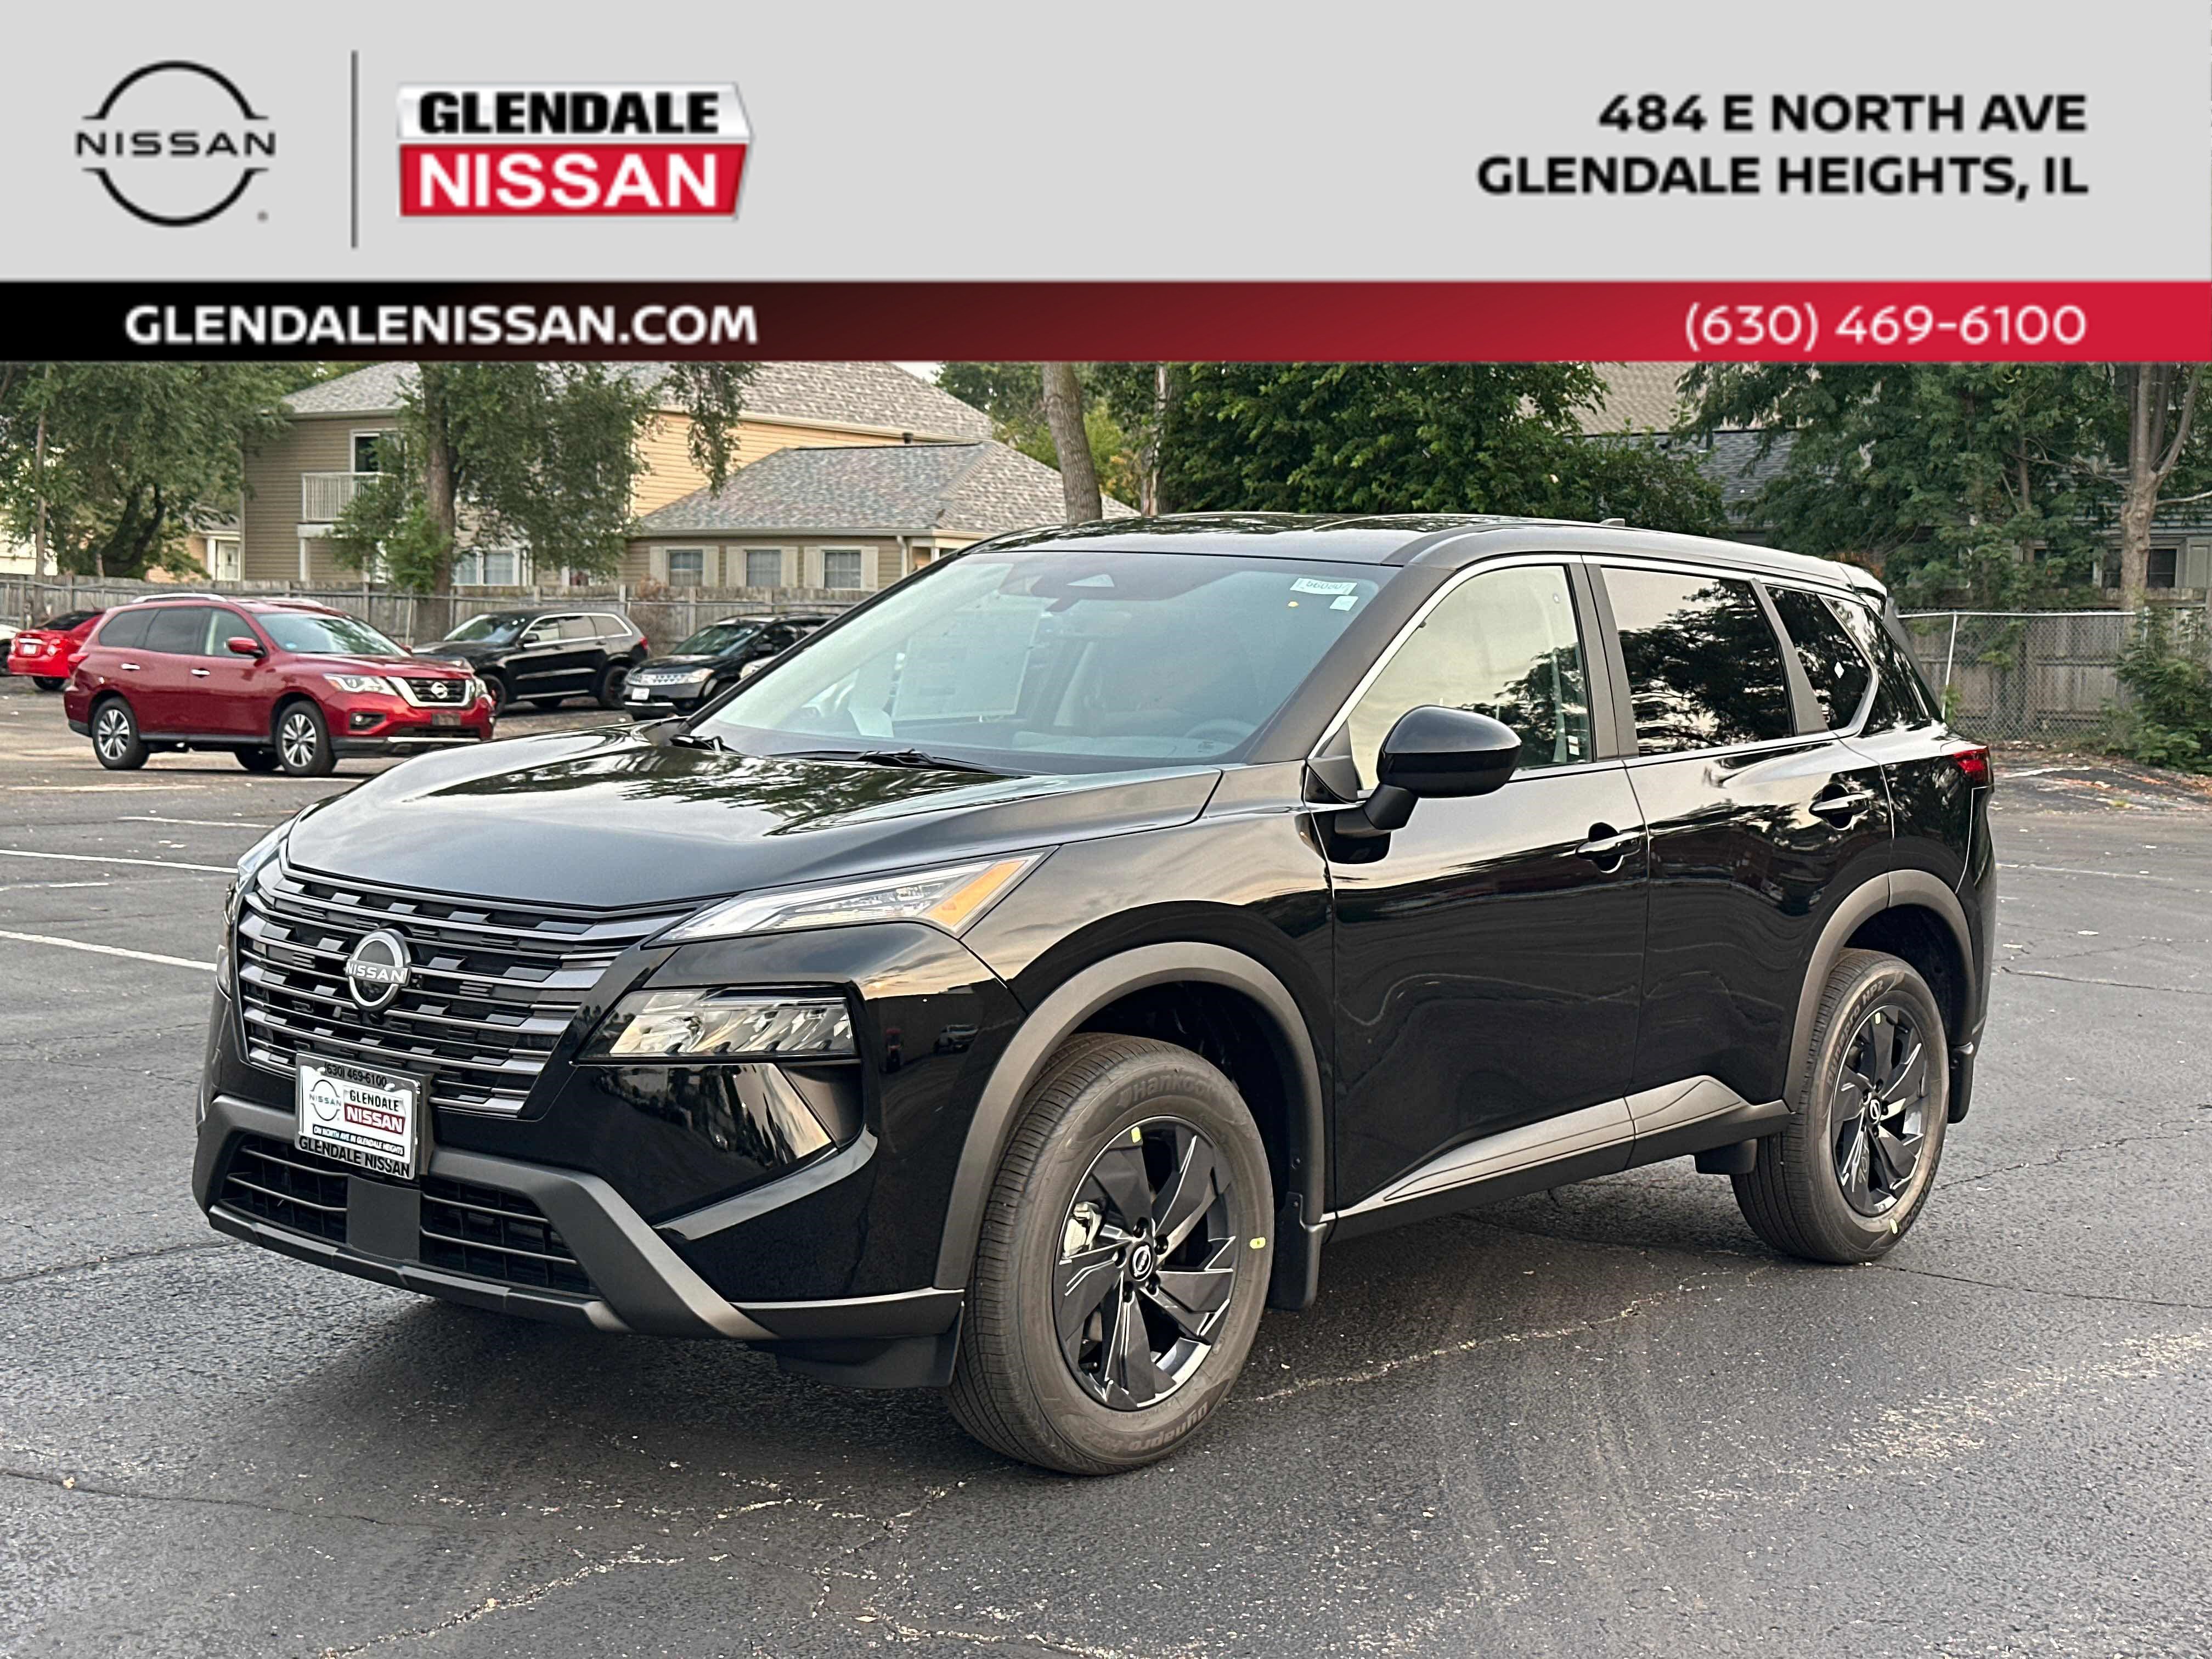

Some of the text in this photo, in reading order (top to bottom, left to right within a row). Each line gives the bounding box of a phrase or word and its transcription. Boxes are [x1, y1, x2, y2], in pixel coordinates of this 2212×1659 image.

[346, 961, 405, 982] NISSAN
[325, 1062, 387, 1088] (630) 469-6100
[309, 1093, 341, 1106] NISSAN
[349, 1090, 399, 1111] GLENDALE
[347, 1106, 402, 1132] NISSAN
[299, 1136, 409, 1177] GLENDALE NISSAN
